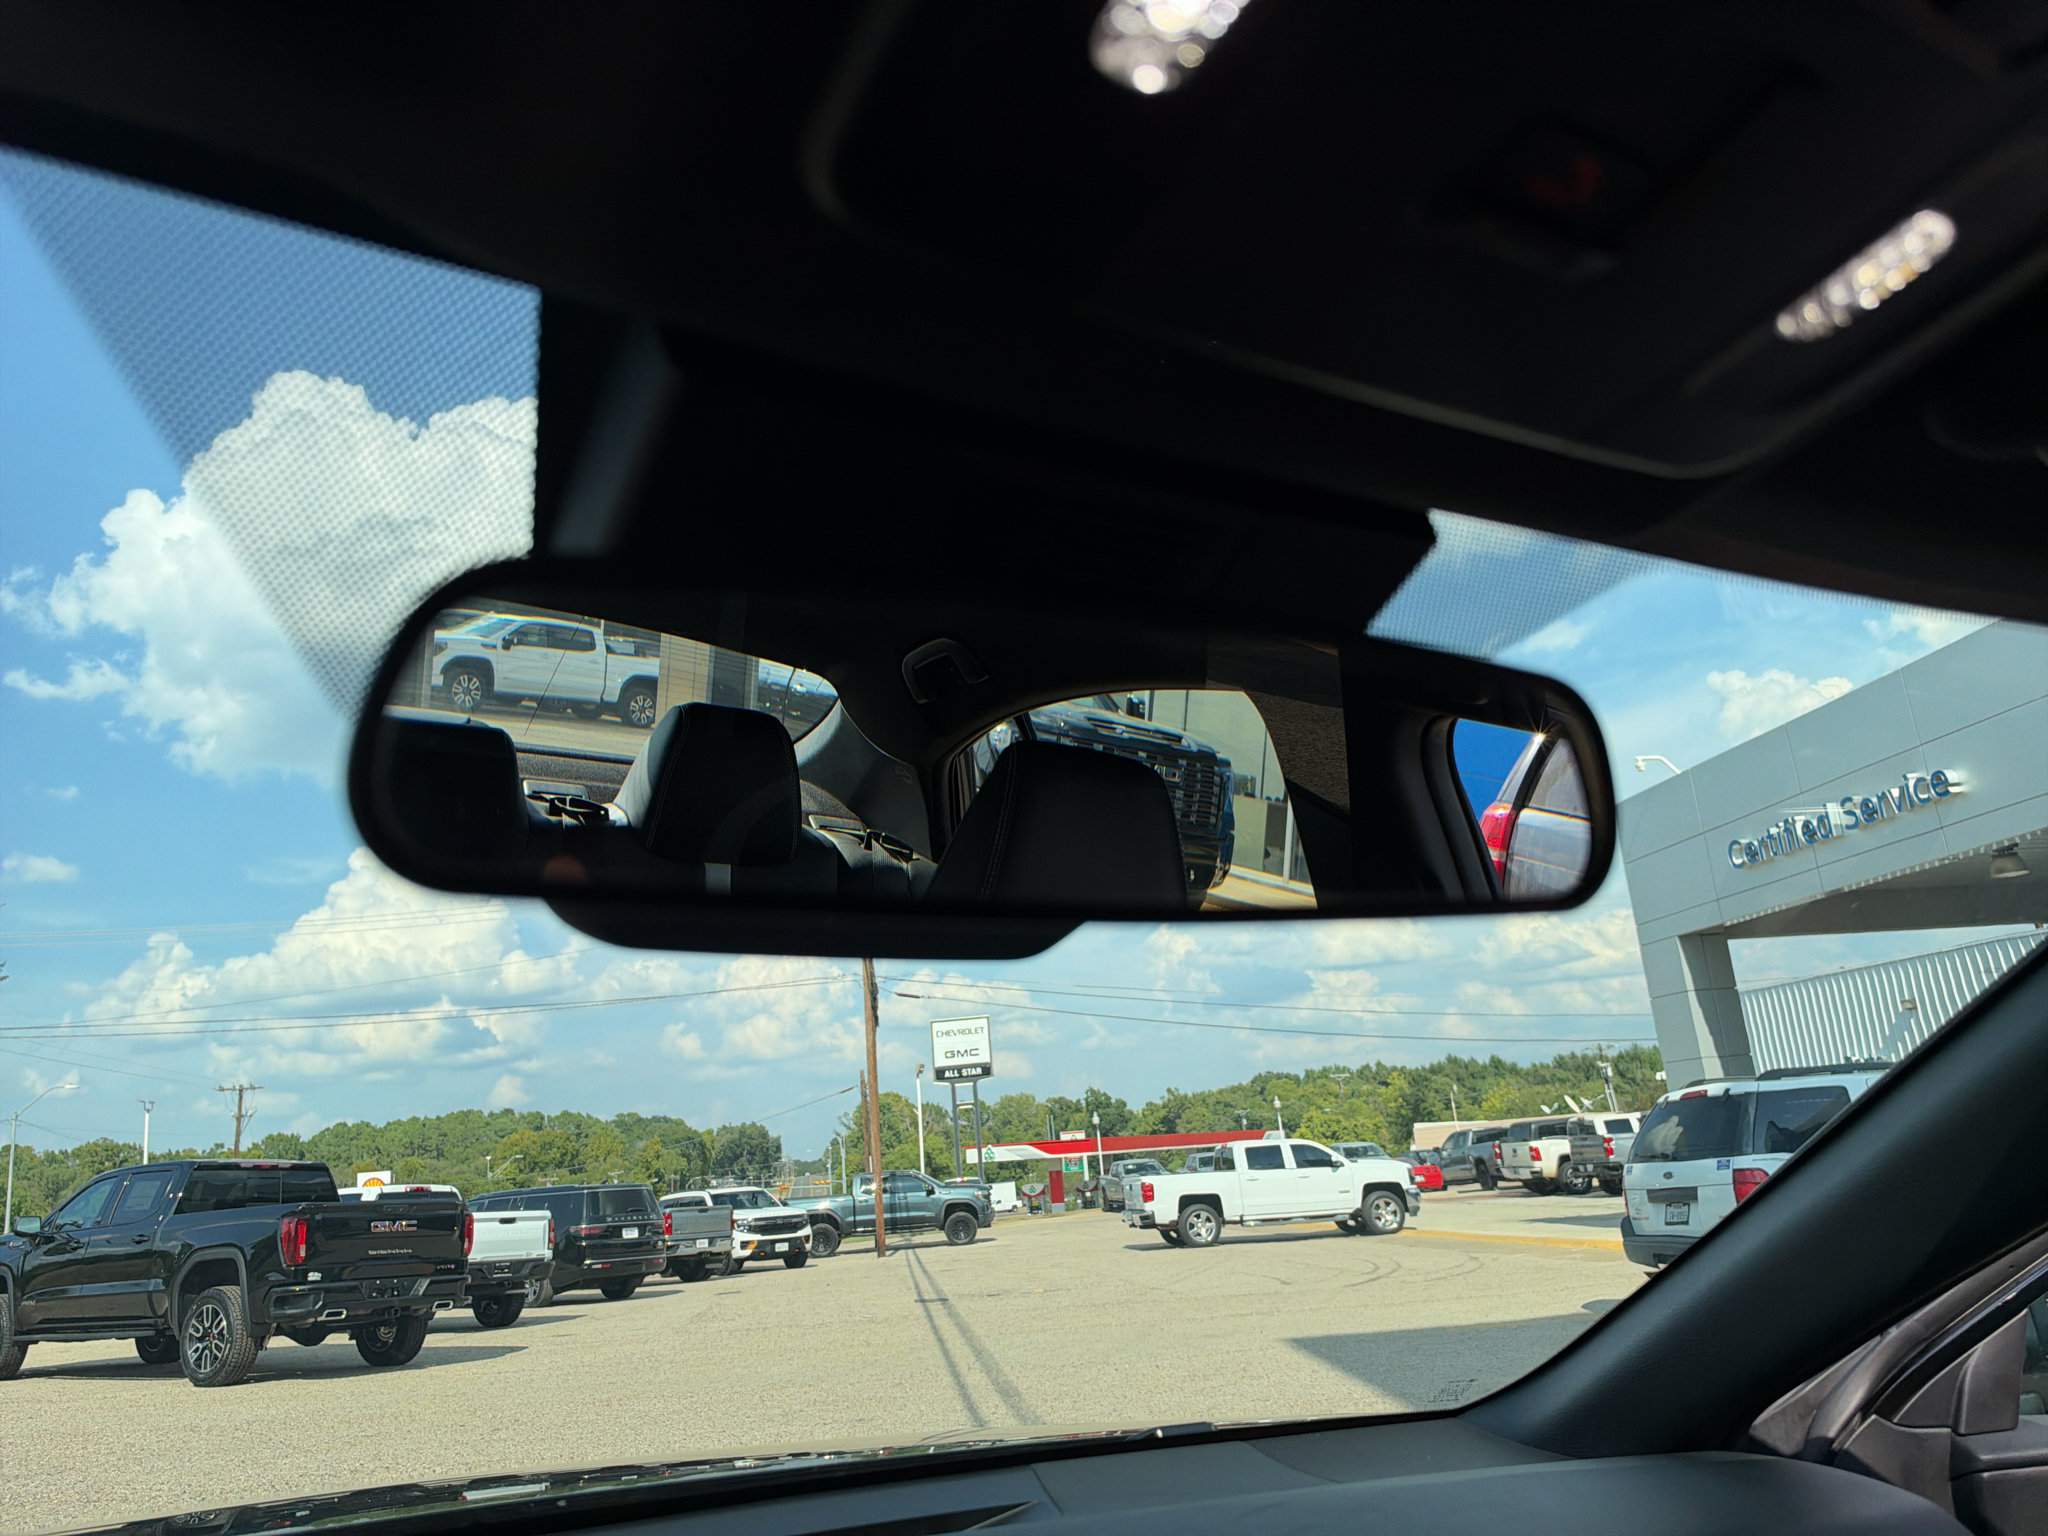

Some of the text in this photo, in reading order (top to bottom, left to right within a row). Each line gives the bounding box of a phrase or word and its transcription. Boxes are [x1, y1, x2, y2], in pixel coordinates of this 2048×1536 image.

[1728, 769, 1951, 869] Certified Service
[935, 1026, 984, 1038] CHEVROLET
[944, 1047, 980, 1059] GMC
[944, 1067, 982, 1078] ALL STAR
[370, 1220, 418, 1233] GMC
